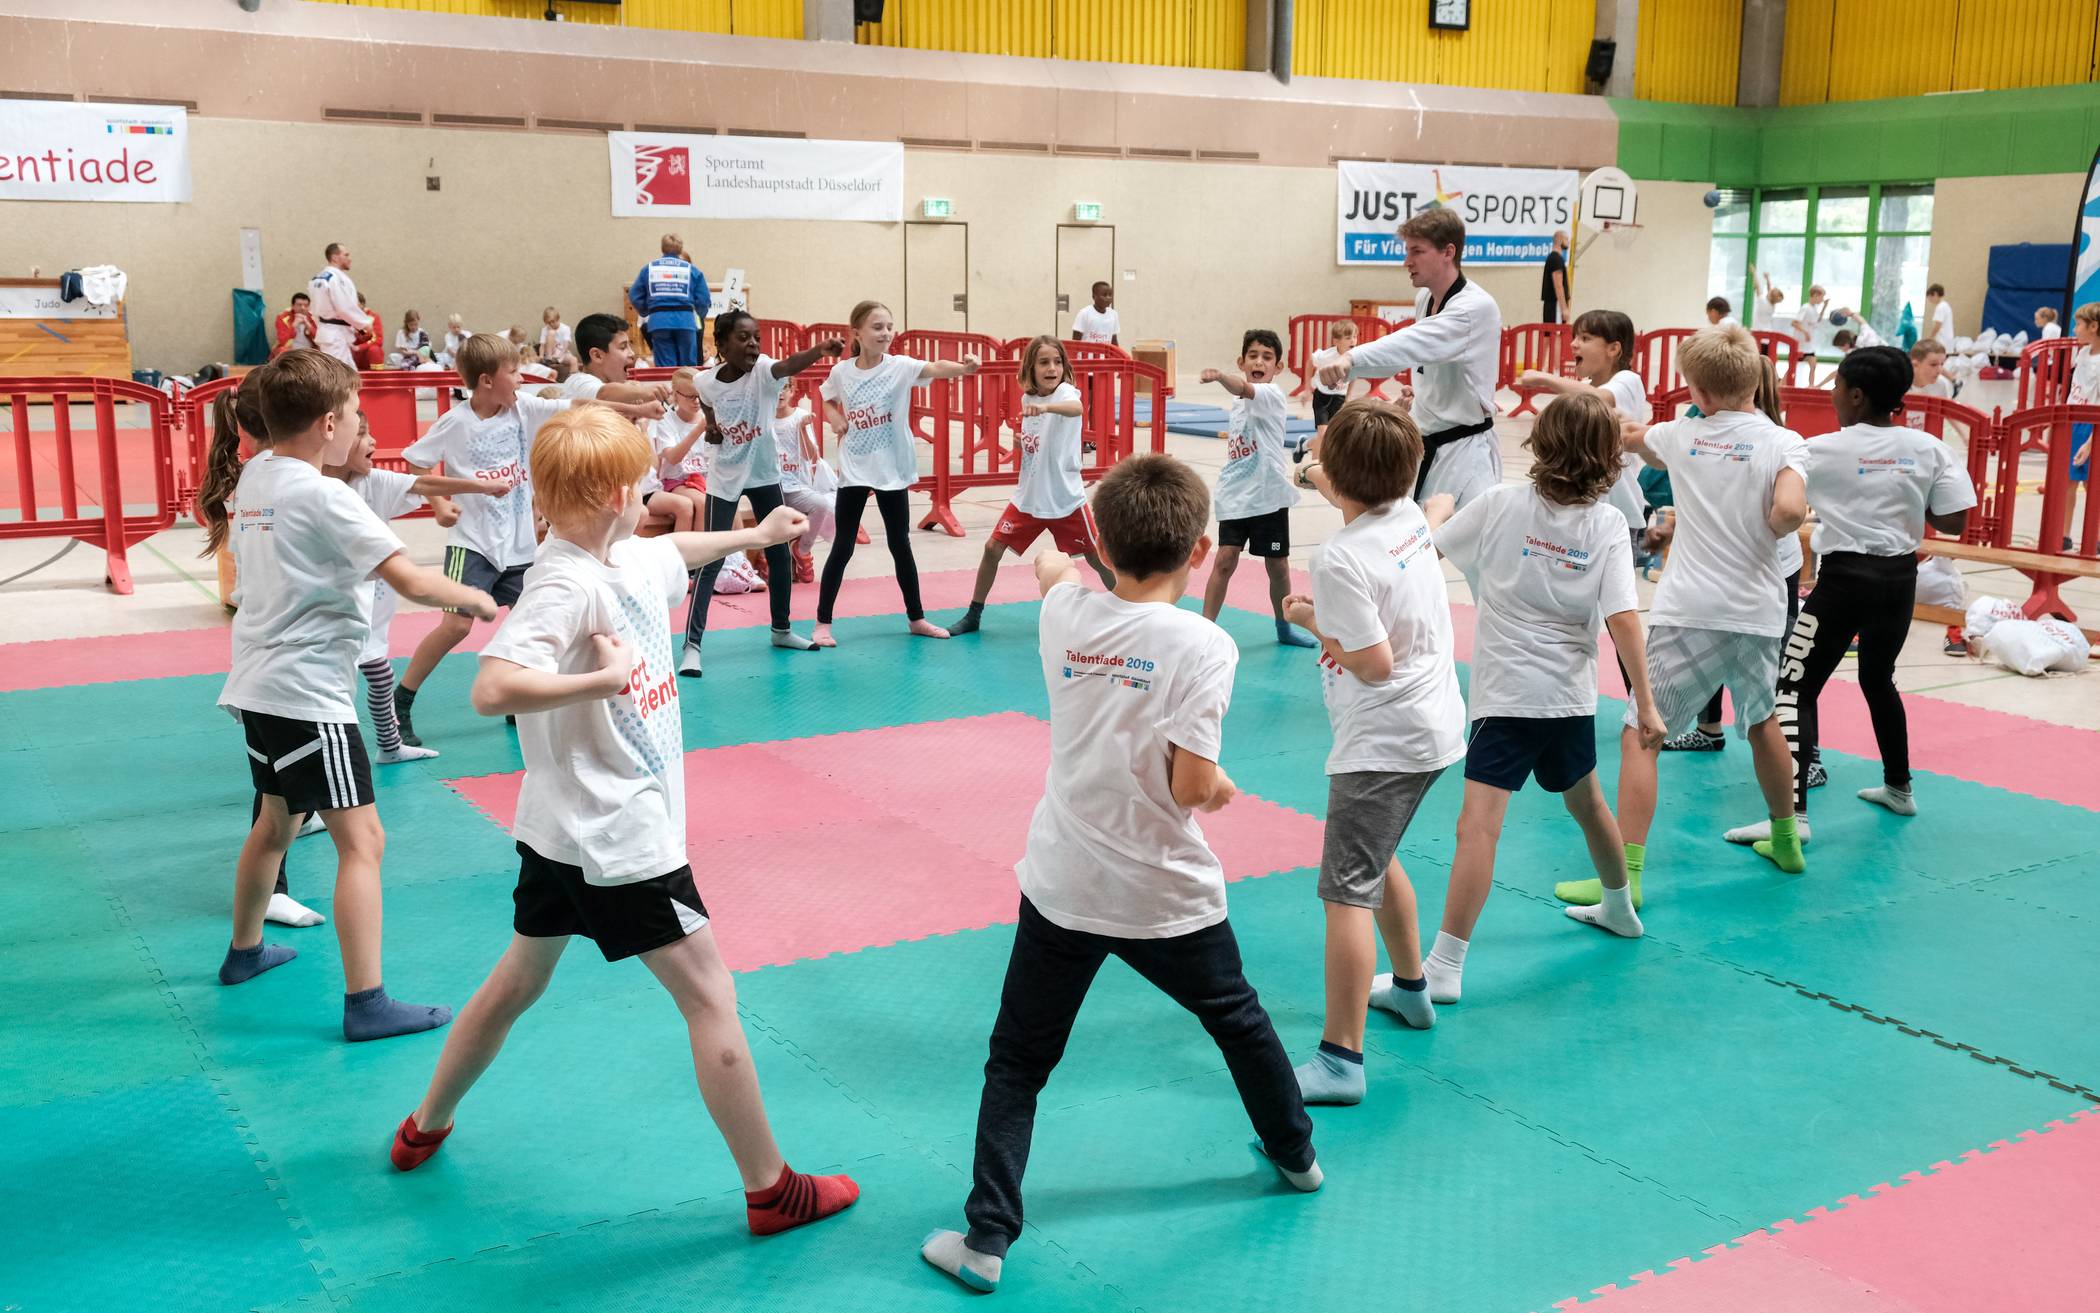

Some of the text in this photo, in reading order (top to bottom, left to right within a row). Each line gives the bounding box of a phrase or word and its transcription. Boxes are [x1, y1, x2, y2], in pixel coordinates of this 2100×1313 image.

[0, 147, 157, 184] entiade
[705, 155, 765, 171] Sportamt
[706, 175, 882, 193] Landeshauptstadt Düsseldorf
[1345, 190, 1568, 224] JUST SPORTS
[1354, 239, 1554, 259] Für Viel gen Homophobi
[34, 299, 61, 309] Judo
[855, 410, 893, 430] talent
[1526, 535, 1566, 554] Talentiade
[1567, 548, 1589, 560] 2019
[1065, 649, 1155, 672] Talentiade 2019
[632, 672, 678, 720] alent
